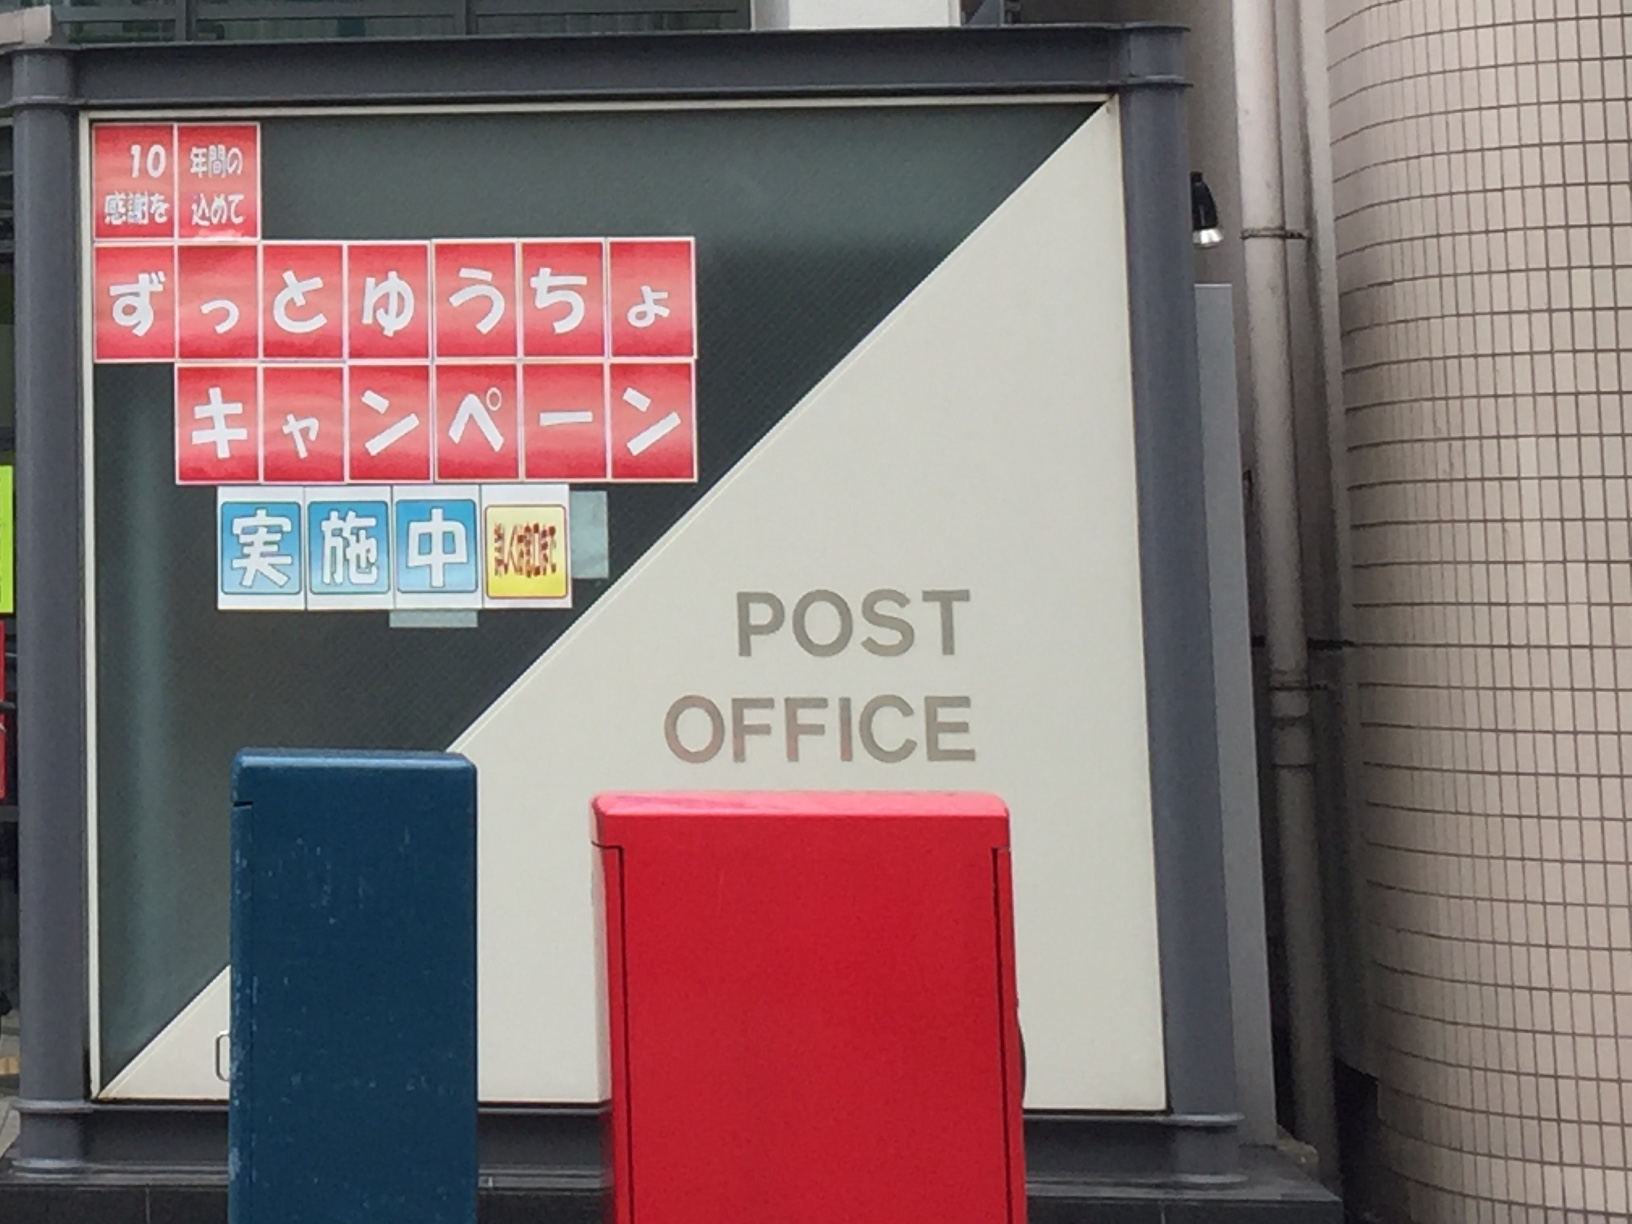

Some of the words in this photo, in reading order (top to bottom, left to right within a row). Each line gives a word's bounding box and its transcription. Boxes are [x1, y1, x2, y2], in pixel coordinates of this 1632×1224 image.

[108, 266, 671, 337] ずっとゆうちょ
[191, 386, 682, 461] キャンペーン
[231, 507, 469, 589] 実施中
[736, 589, 971, 658] POST
[664, 694, 976, 764] OFFICE
